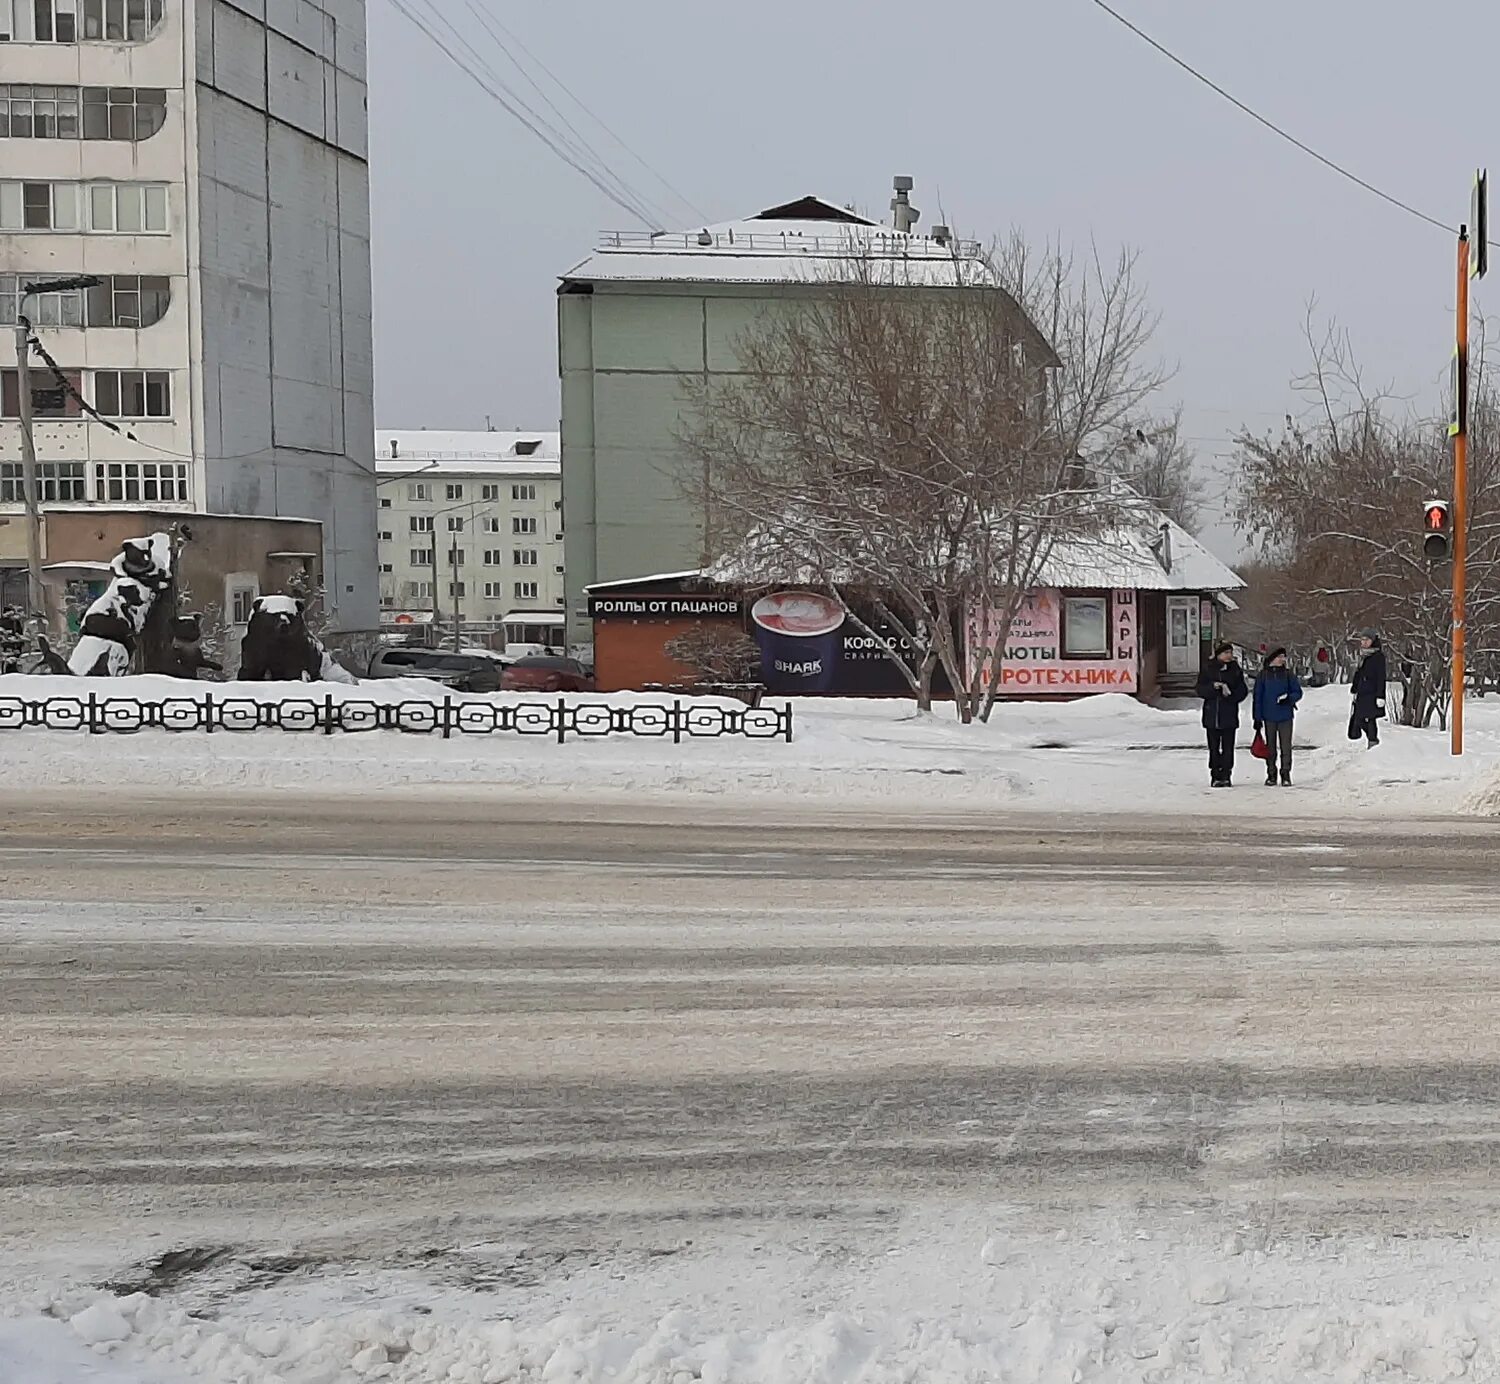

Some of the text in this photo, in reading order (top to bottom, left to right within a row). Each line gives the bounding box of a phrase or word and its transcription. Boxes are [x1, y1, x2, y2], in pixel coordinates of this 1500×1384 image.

[595, 602, 738, 613] РОЛЛЫ ОТ ПАЦАНОВ
[1117, 591, 1133, 660] ШАРЫ
[774, 659, 822, 674] SHARK
[982, 668, 1133, 685] РОТЕХНИКА
